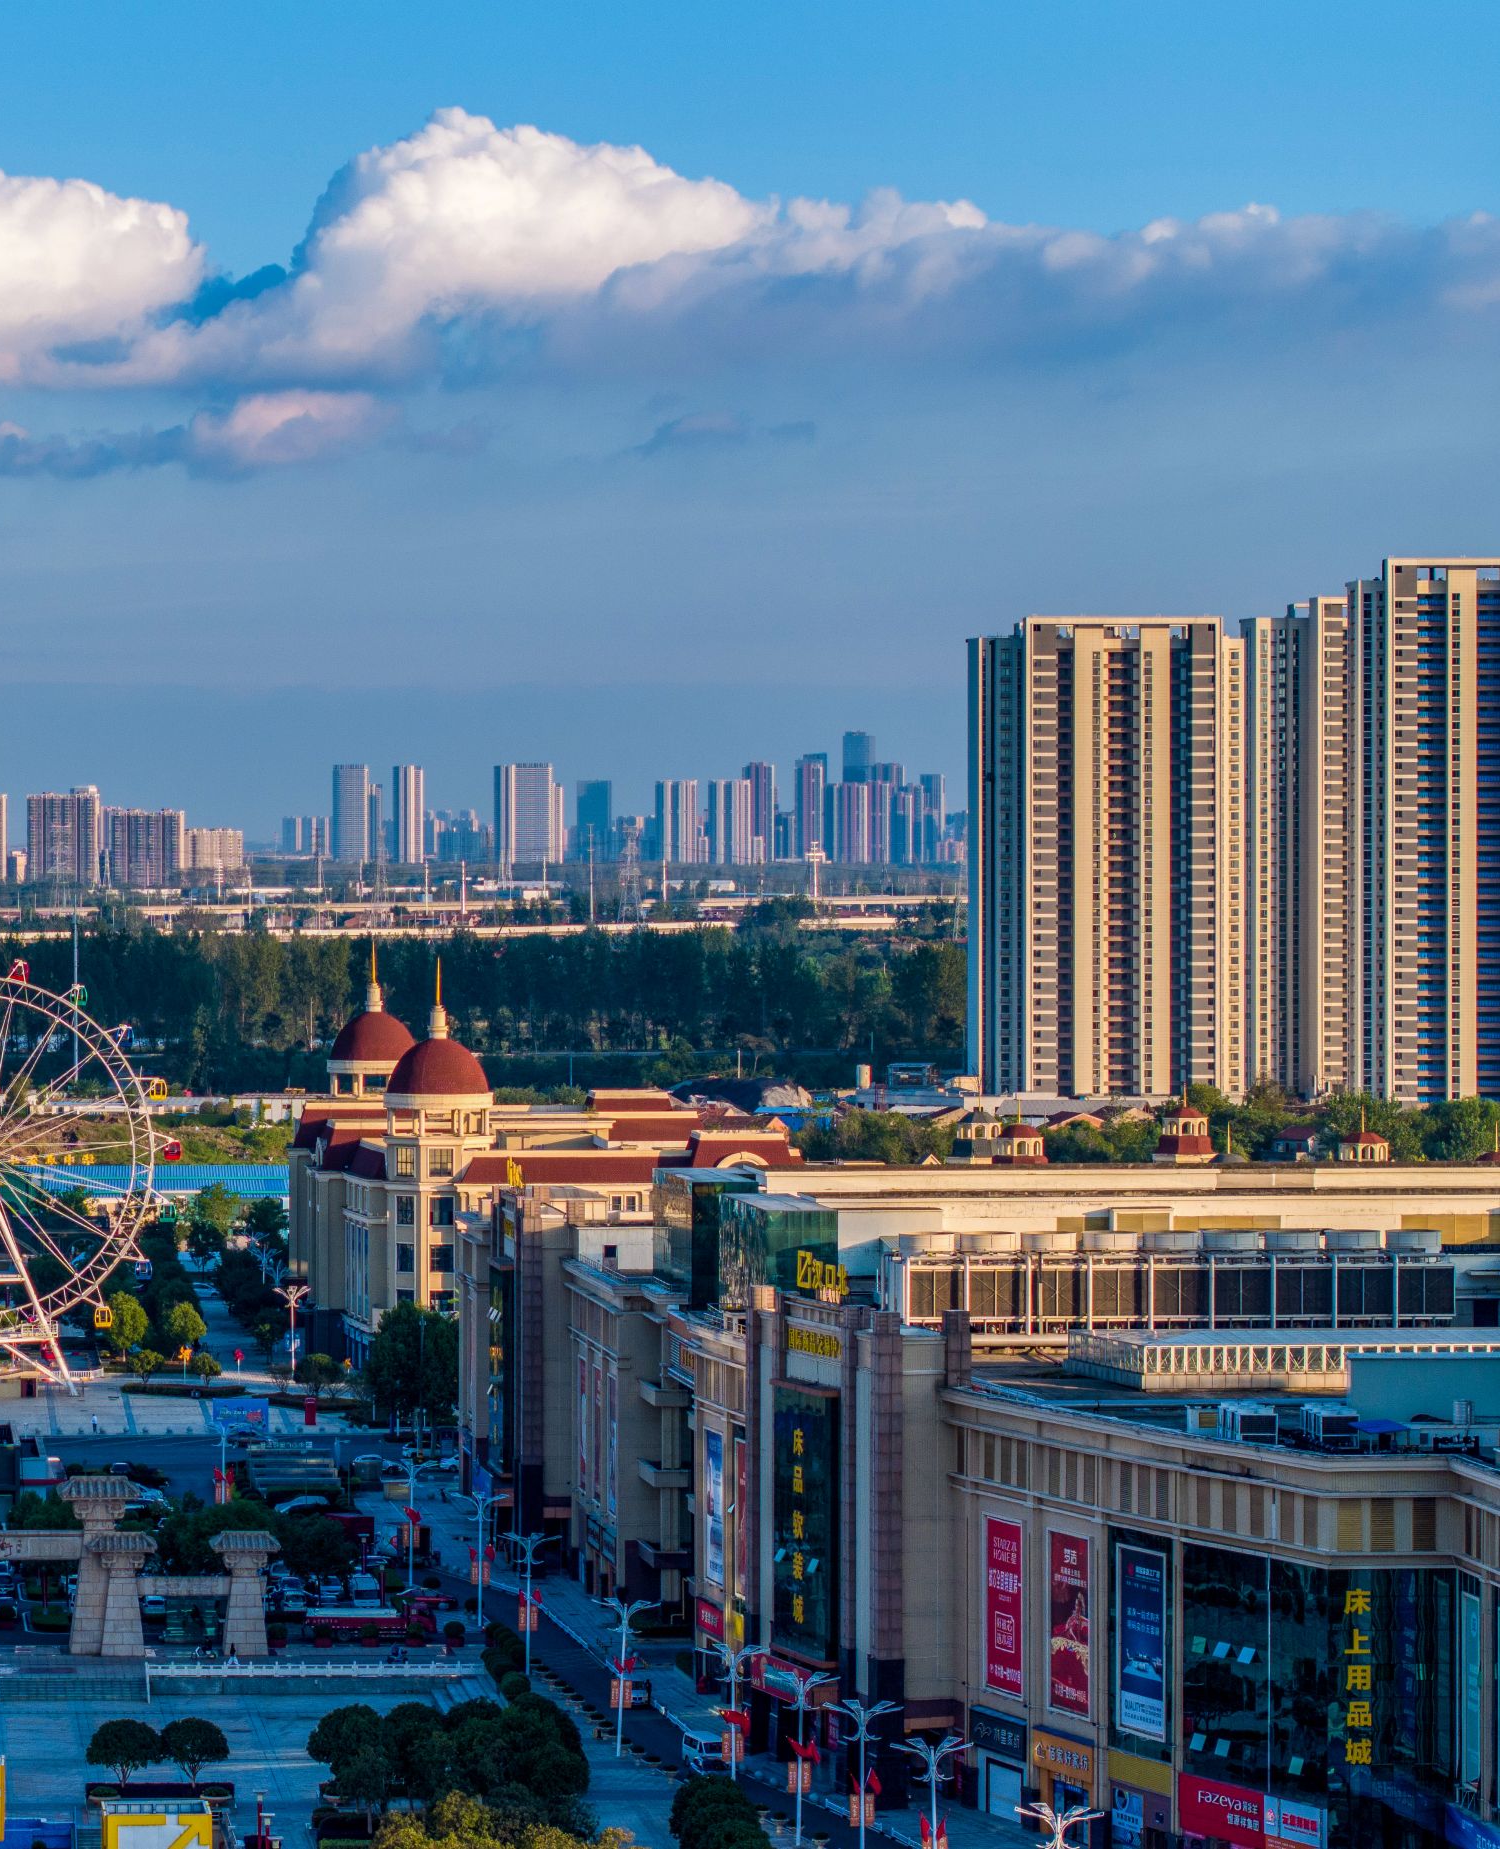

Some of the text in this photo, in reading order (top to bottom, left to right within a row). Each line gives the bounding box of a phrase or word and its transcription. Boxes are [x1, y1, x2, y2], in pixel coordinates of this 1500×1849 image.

[812, 1259, 850, 1295] 汉口北
[1344, 1588, 1372, 1765] 床上用品城
[1197, 1790, 1242, 1811] Fazeya
